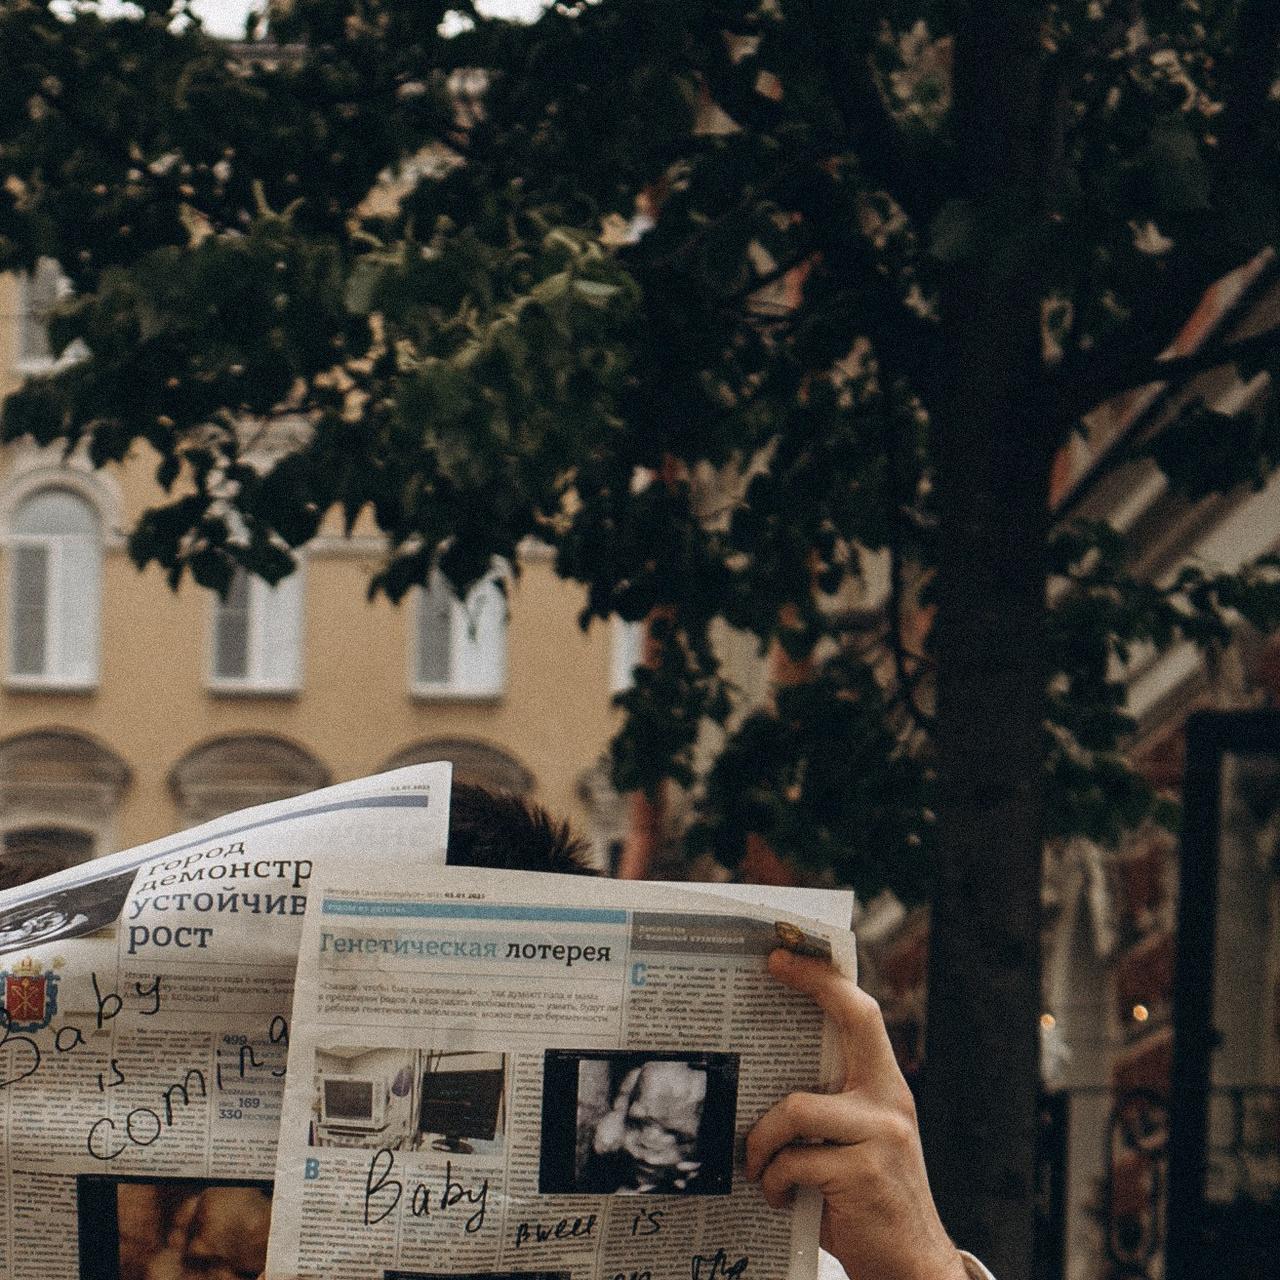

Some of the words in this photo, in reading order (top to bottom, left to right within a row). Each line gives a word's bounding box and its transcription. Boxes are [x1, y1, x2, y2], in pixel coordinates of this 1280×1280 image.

[149, 841, 246, 877] город
[136, 859, 313, 895] демонстр
[129, 885, 308, 920] устойчив
[129, 924, 213, 955] рост
[320, 933, 498, 959] Генетическая
[505, 942, 612, 967] лотерея
[96, 1058, 125, 1092] is
[218, 1108, 243, 1120] 330
[238, 1097, 261, 1109] 169
[363, 1147, 489, 1234] Baby
[631, 1207, 664, 1236] is
